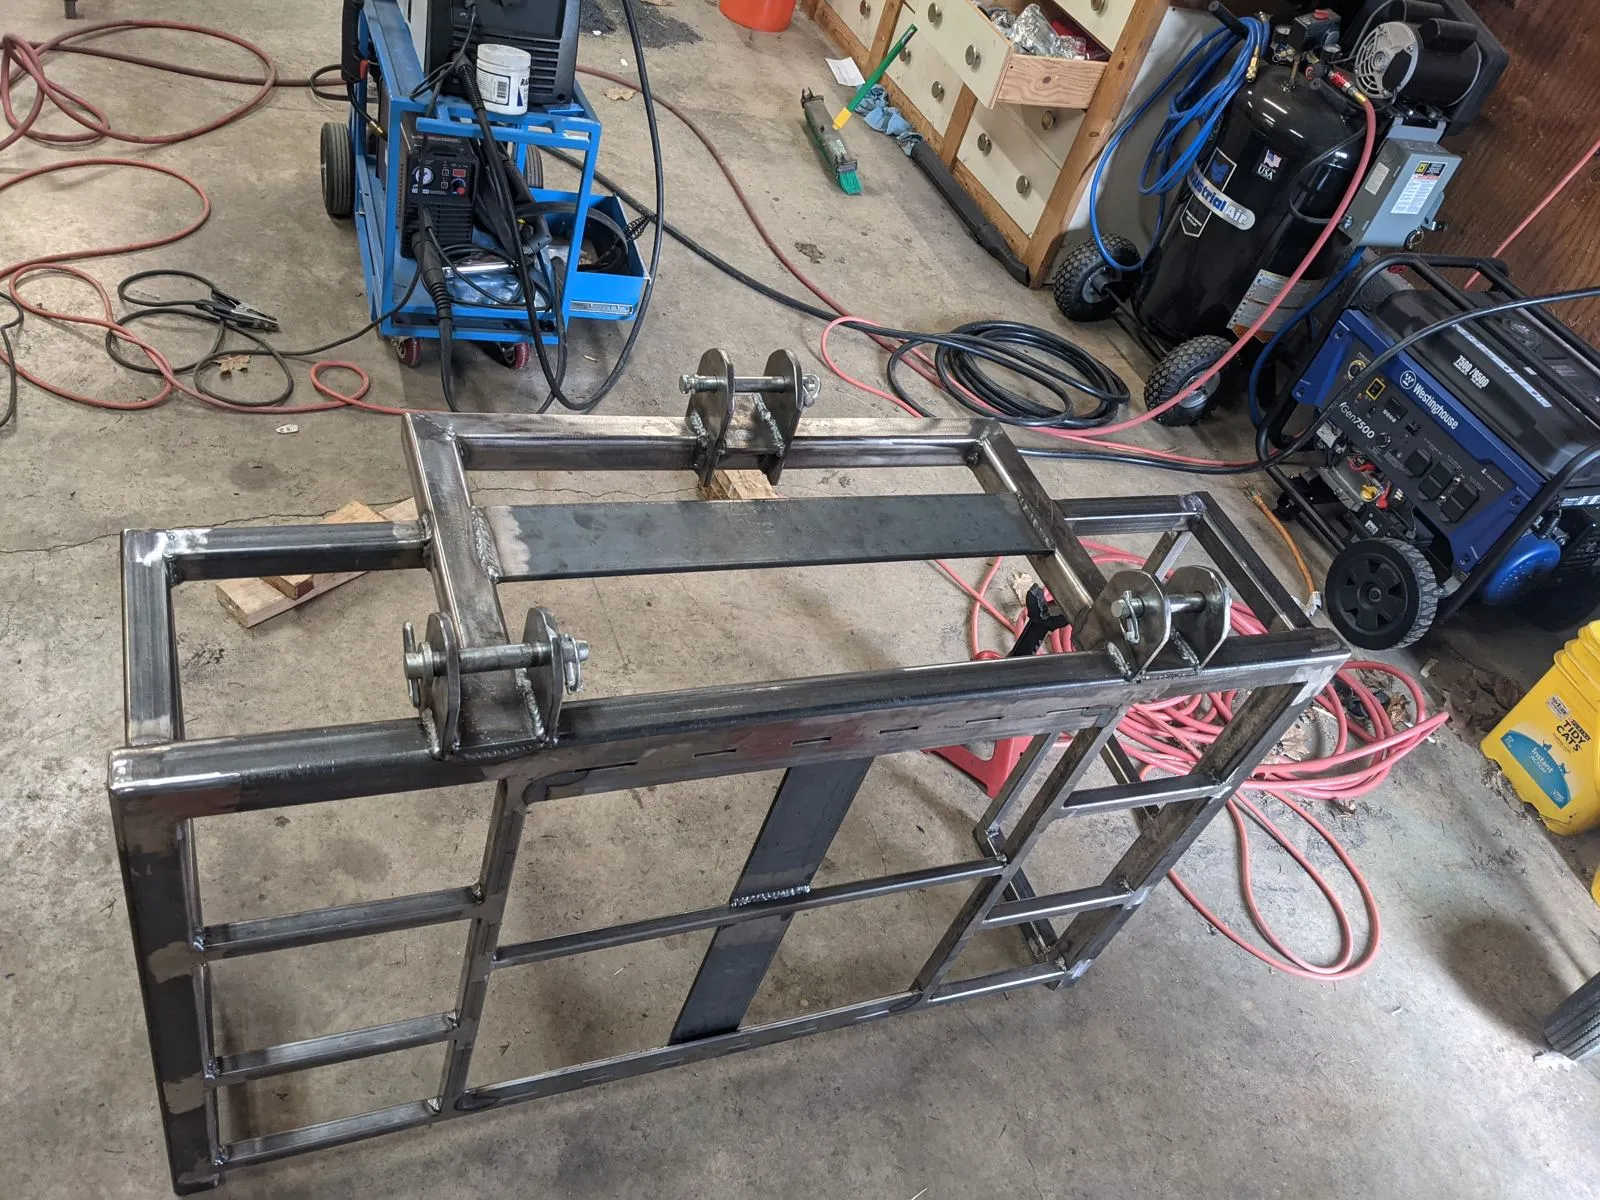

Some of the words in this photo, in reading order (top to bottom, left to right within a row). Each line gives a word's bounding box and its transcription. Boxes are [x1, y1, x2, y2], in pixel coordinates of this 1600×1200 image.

[1257, 165, 1273, 180] USA
[1224, 205, 1247, 223] Air
[1413, 383, 1458, 430] Westinghouse
[1556, 725, 1581, 752] CATS
[1563, 719, 1587, 744] TIDY
[1531, 747, 1553, 774] Instant
